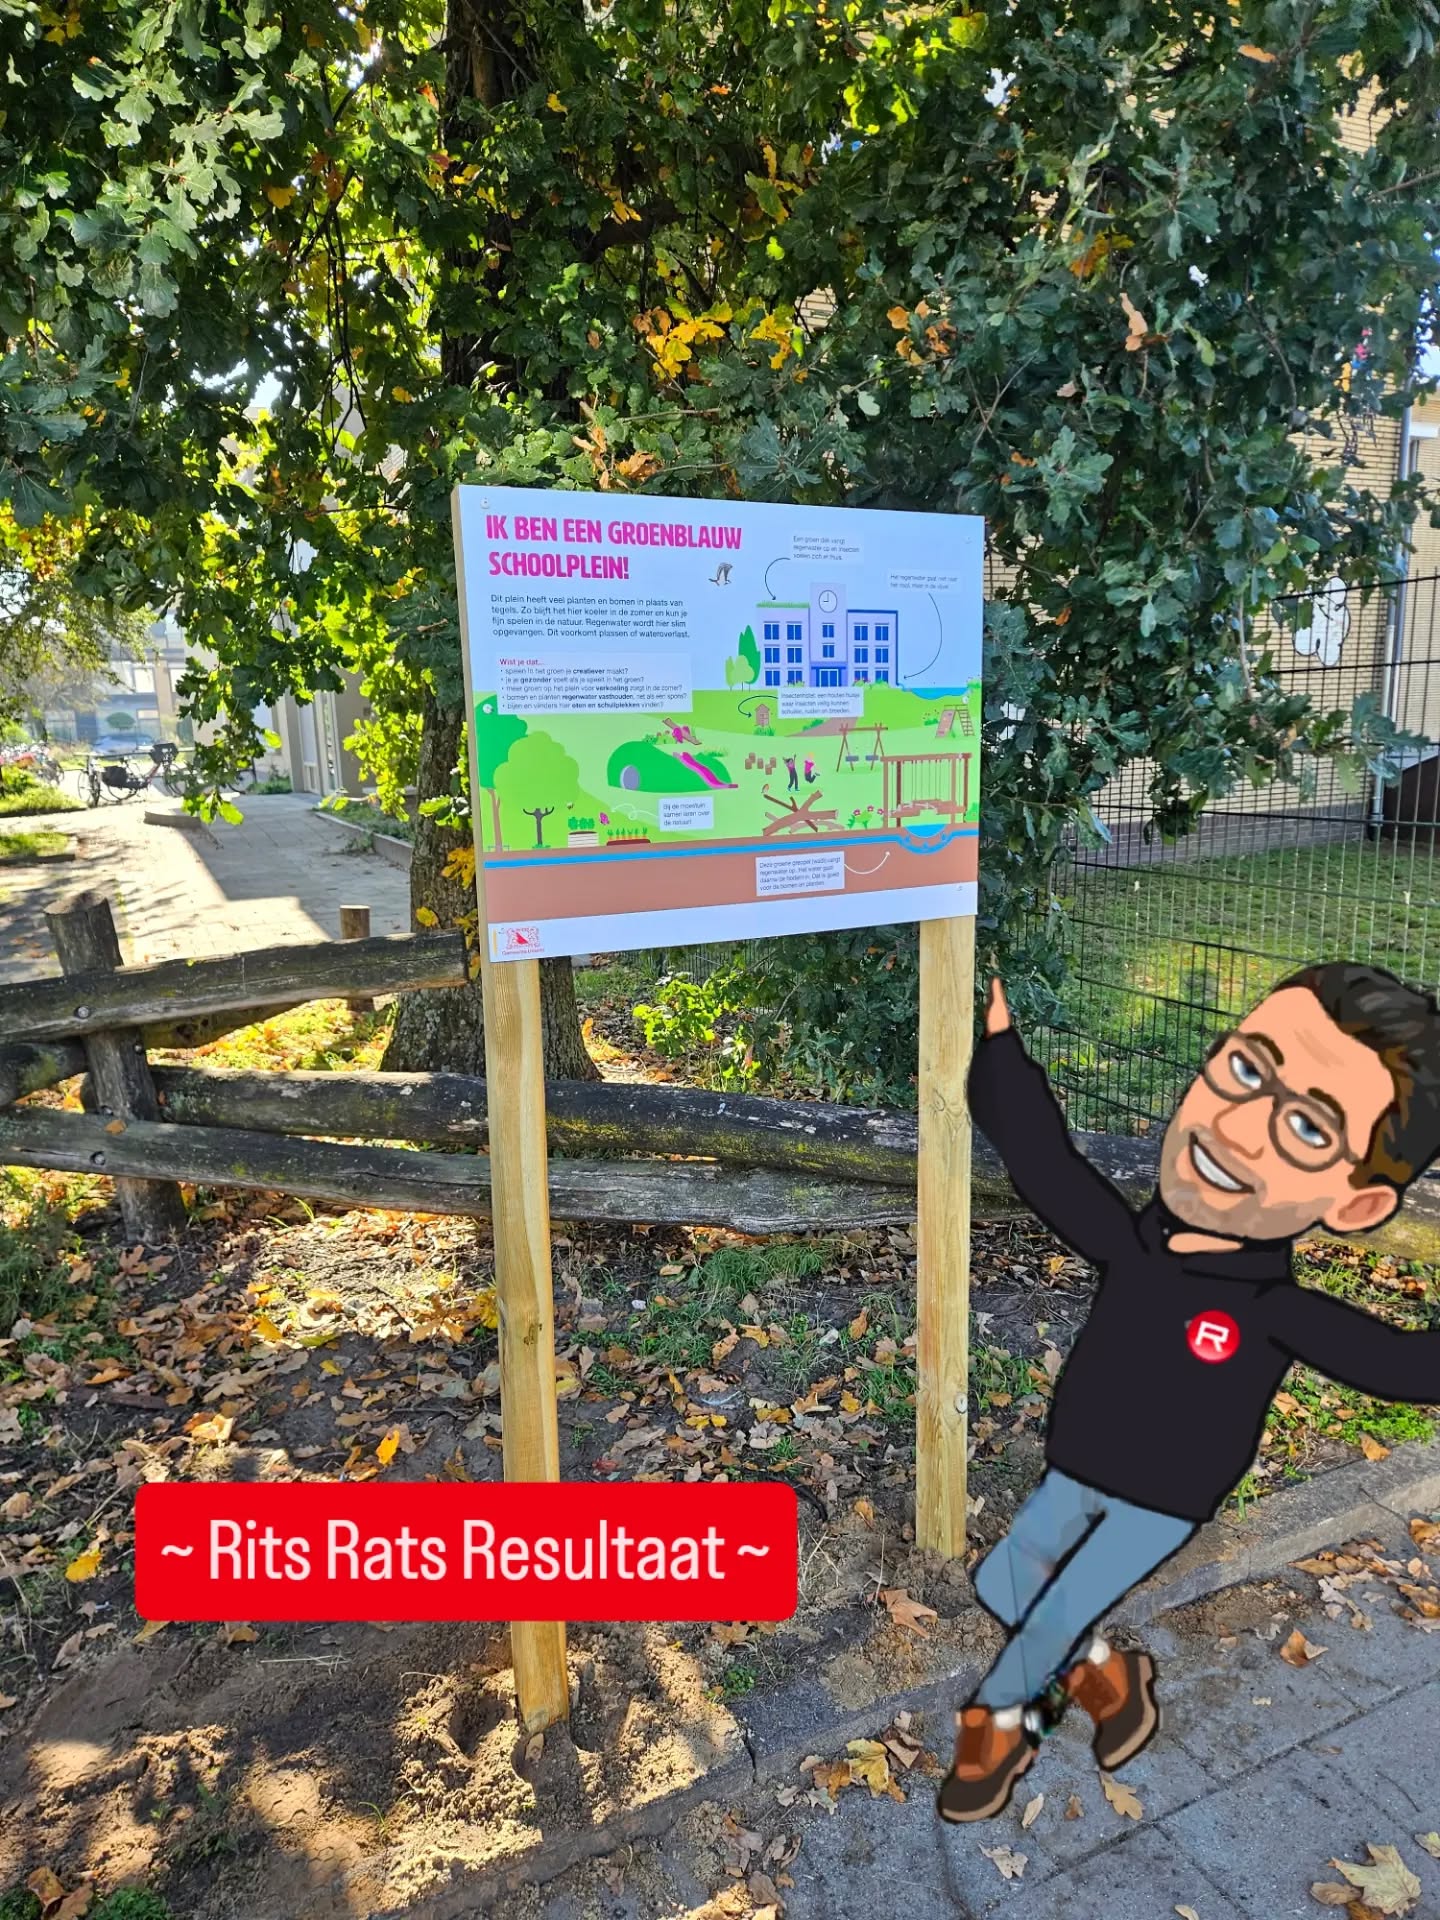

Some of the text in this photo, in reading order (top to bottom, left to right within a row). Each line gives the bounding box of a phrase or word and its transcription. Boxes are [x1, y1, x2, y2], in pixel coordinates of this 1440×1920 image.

[486, 515, 742, 549] IK BEN EEN GROENBLAUW
[489, 552, 629, 579] SCHOOLPLEIN!
[490, 594, 502, 602] Dit
[505, 595, 524, 604] plein
[526, 595, 547, 603] heeft
[549, 596, 565, 604] veel
[567, 597, 596, 605] planten
[646, 598, 668, 607] plaats
[491, 606, 519, 615] tegels.
[521, 606, 532, 614] Zo
[534, 606, 551, 616] blijft
[568, 607, 582, 615] hier
[618, 608, 628, 616] de
[665, 609, 679, 617] kun
[680, 610, 688, 618] je
[507, 617, 533, 626] spelen
[544, 617, 555, 625] de
[585, 618, 631, 628] Regenwater
[632, 619, 654, 627] wordt
[655, 619, 669, 627] hier
[671, 619, 686, 627] slim
[492, 629, 544, 637] opgevangen.
[547, 628, 558, 636] Dit
[561, 629, 597, 637] voorkomt
[599, 630, 628, 638] plassen
[640, 630, 690, 638] wateroverlast.
